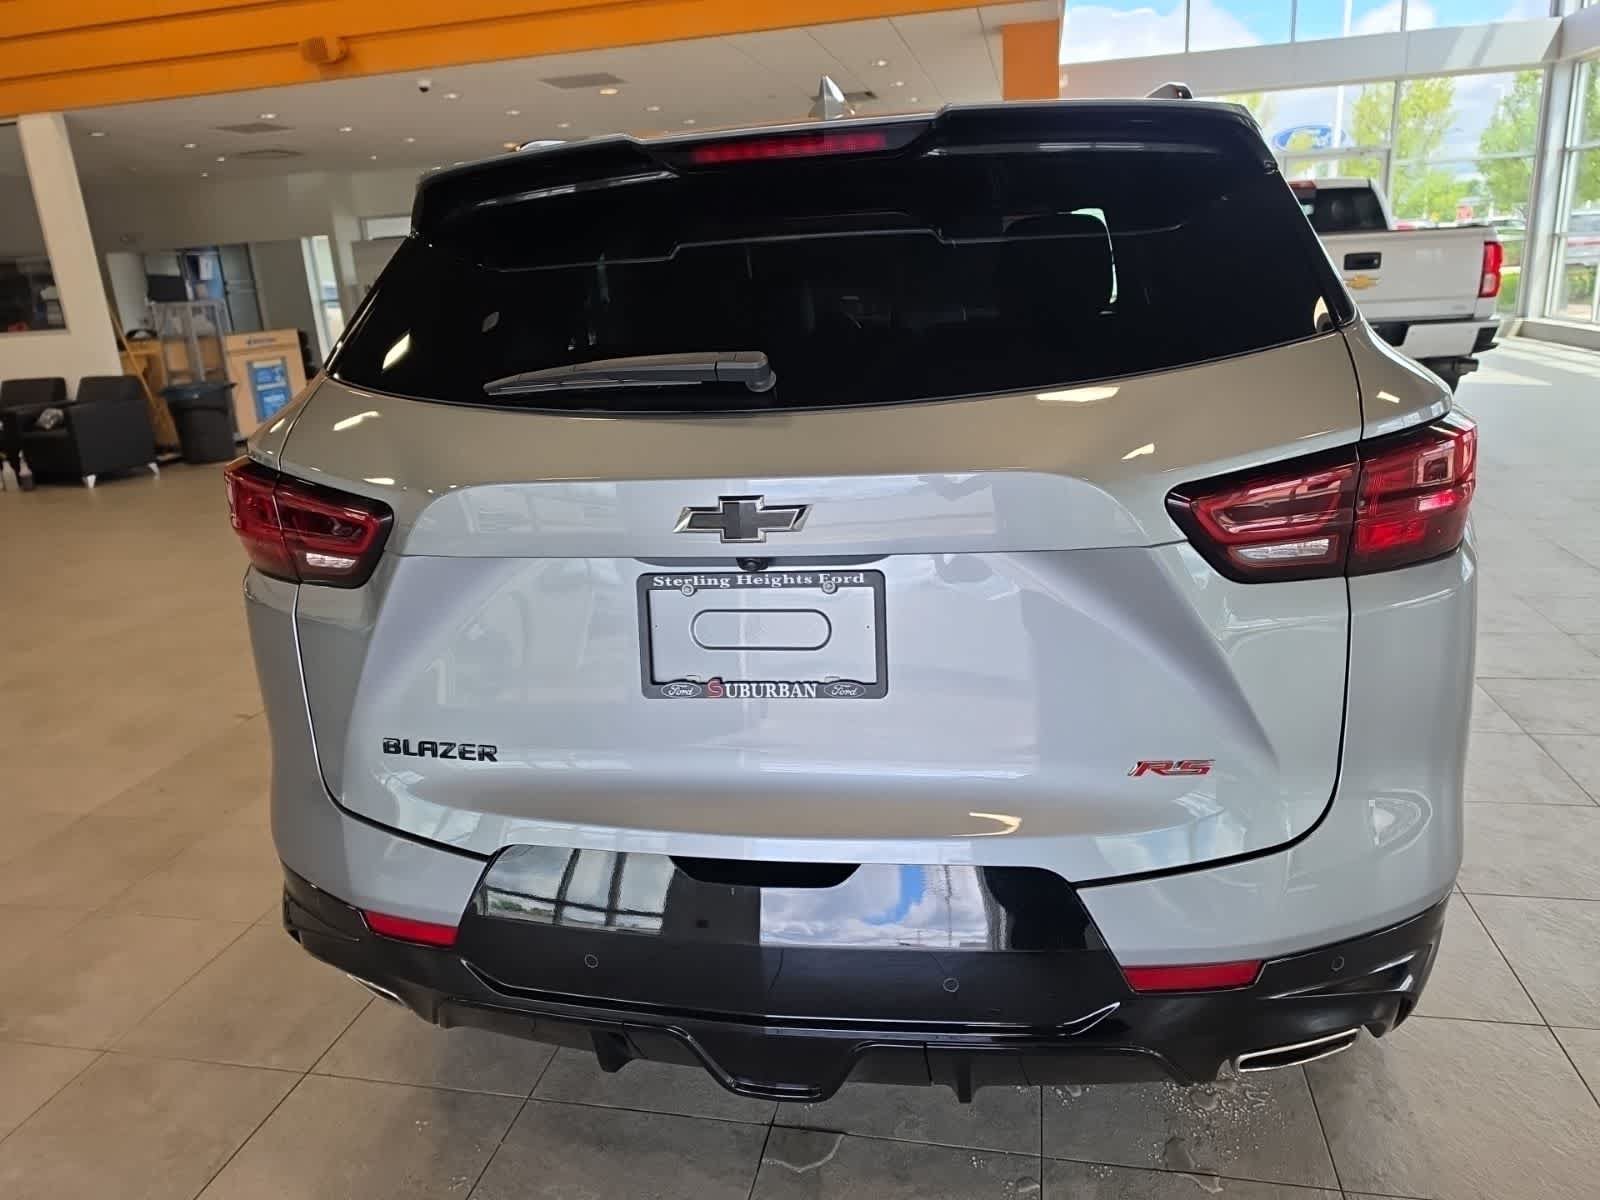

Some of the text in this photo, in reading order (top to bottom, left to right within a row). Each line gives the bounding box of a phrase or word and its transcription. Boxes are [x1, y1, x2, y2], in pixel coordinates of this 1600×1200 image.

[652, 572, 865, 588] Sterling Heights Ford
[706, 680, 817, 699] SUBURBAN
[382, 737, 498, 762] BLAZER
[1127, 759, 1216, 777] RS
